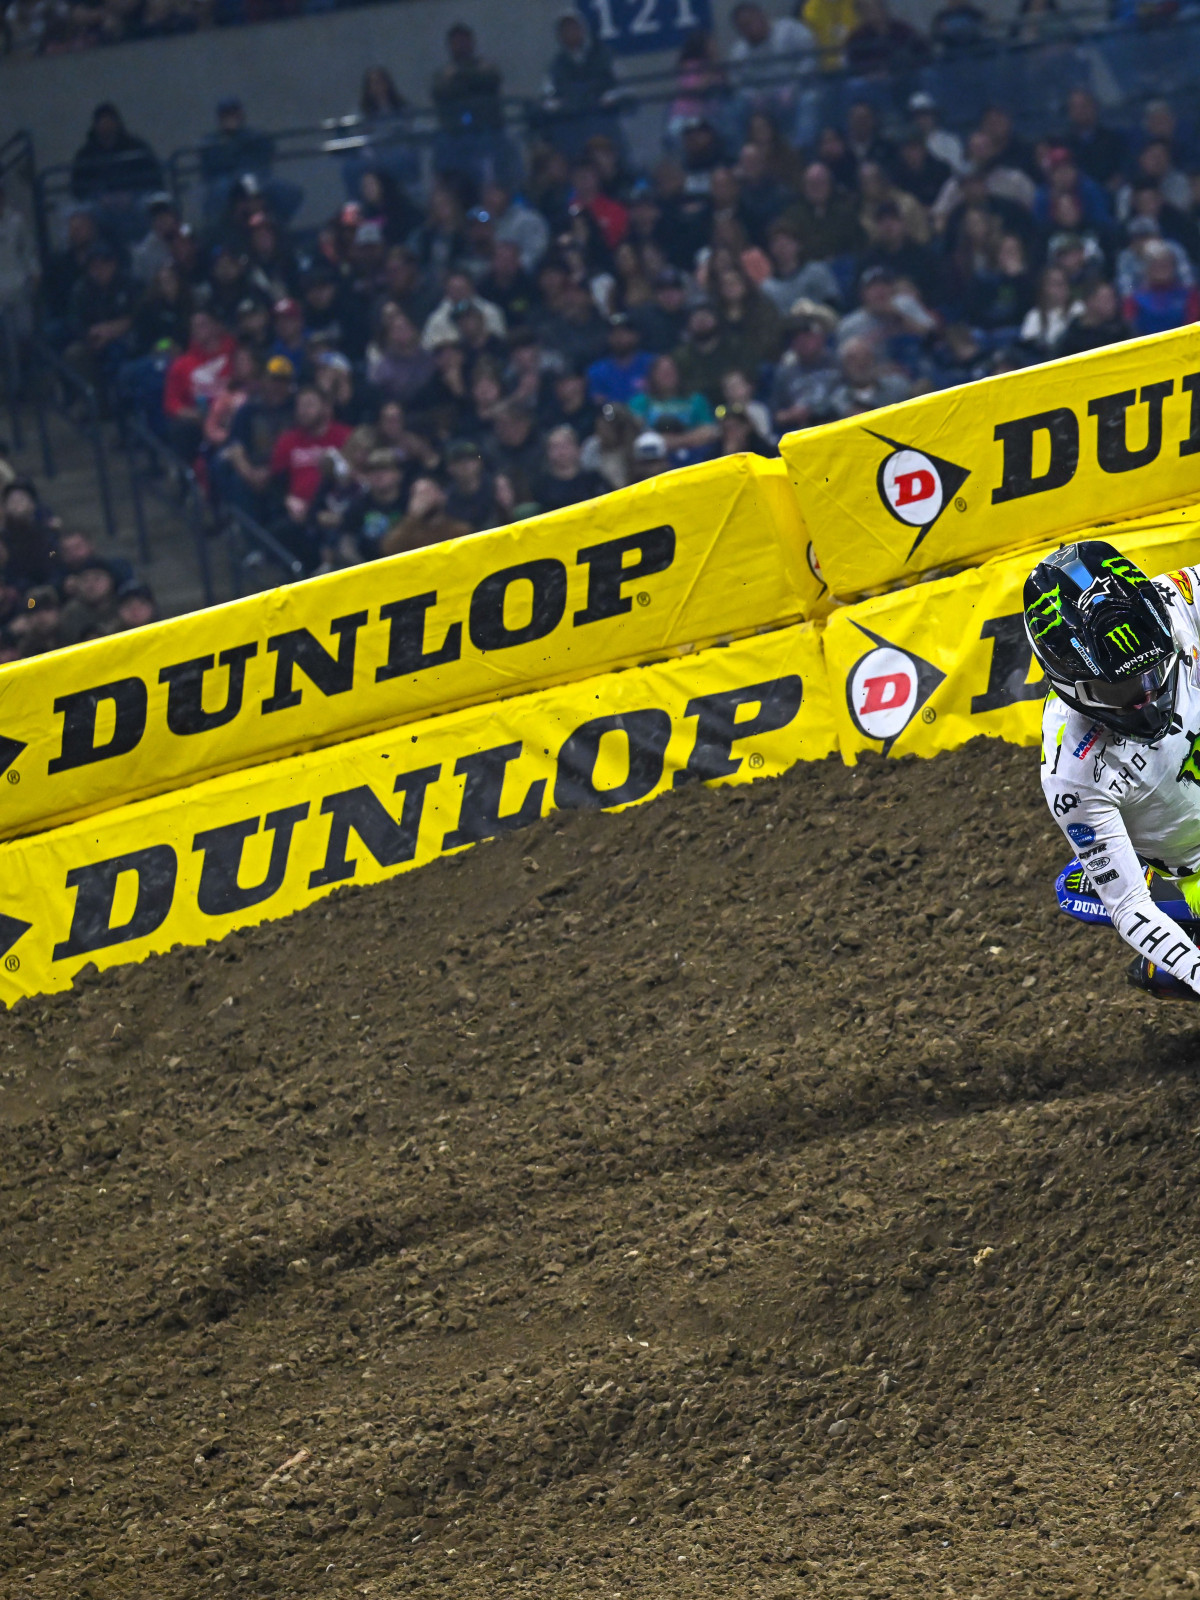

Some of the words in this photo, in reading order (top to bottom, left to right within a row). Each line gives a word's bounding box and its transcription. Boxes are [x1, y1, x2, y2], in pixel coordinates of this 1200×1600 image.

[592, 0, 697, 39] 121
[48, 525, 676, 775] DUNLOP
[1115, 647, 1165, 675] MONSTER
[52, 674, 803, 962] DUNLOP
